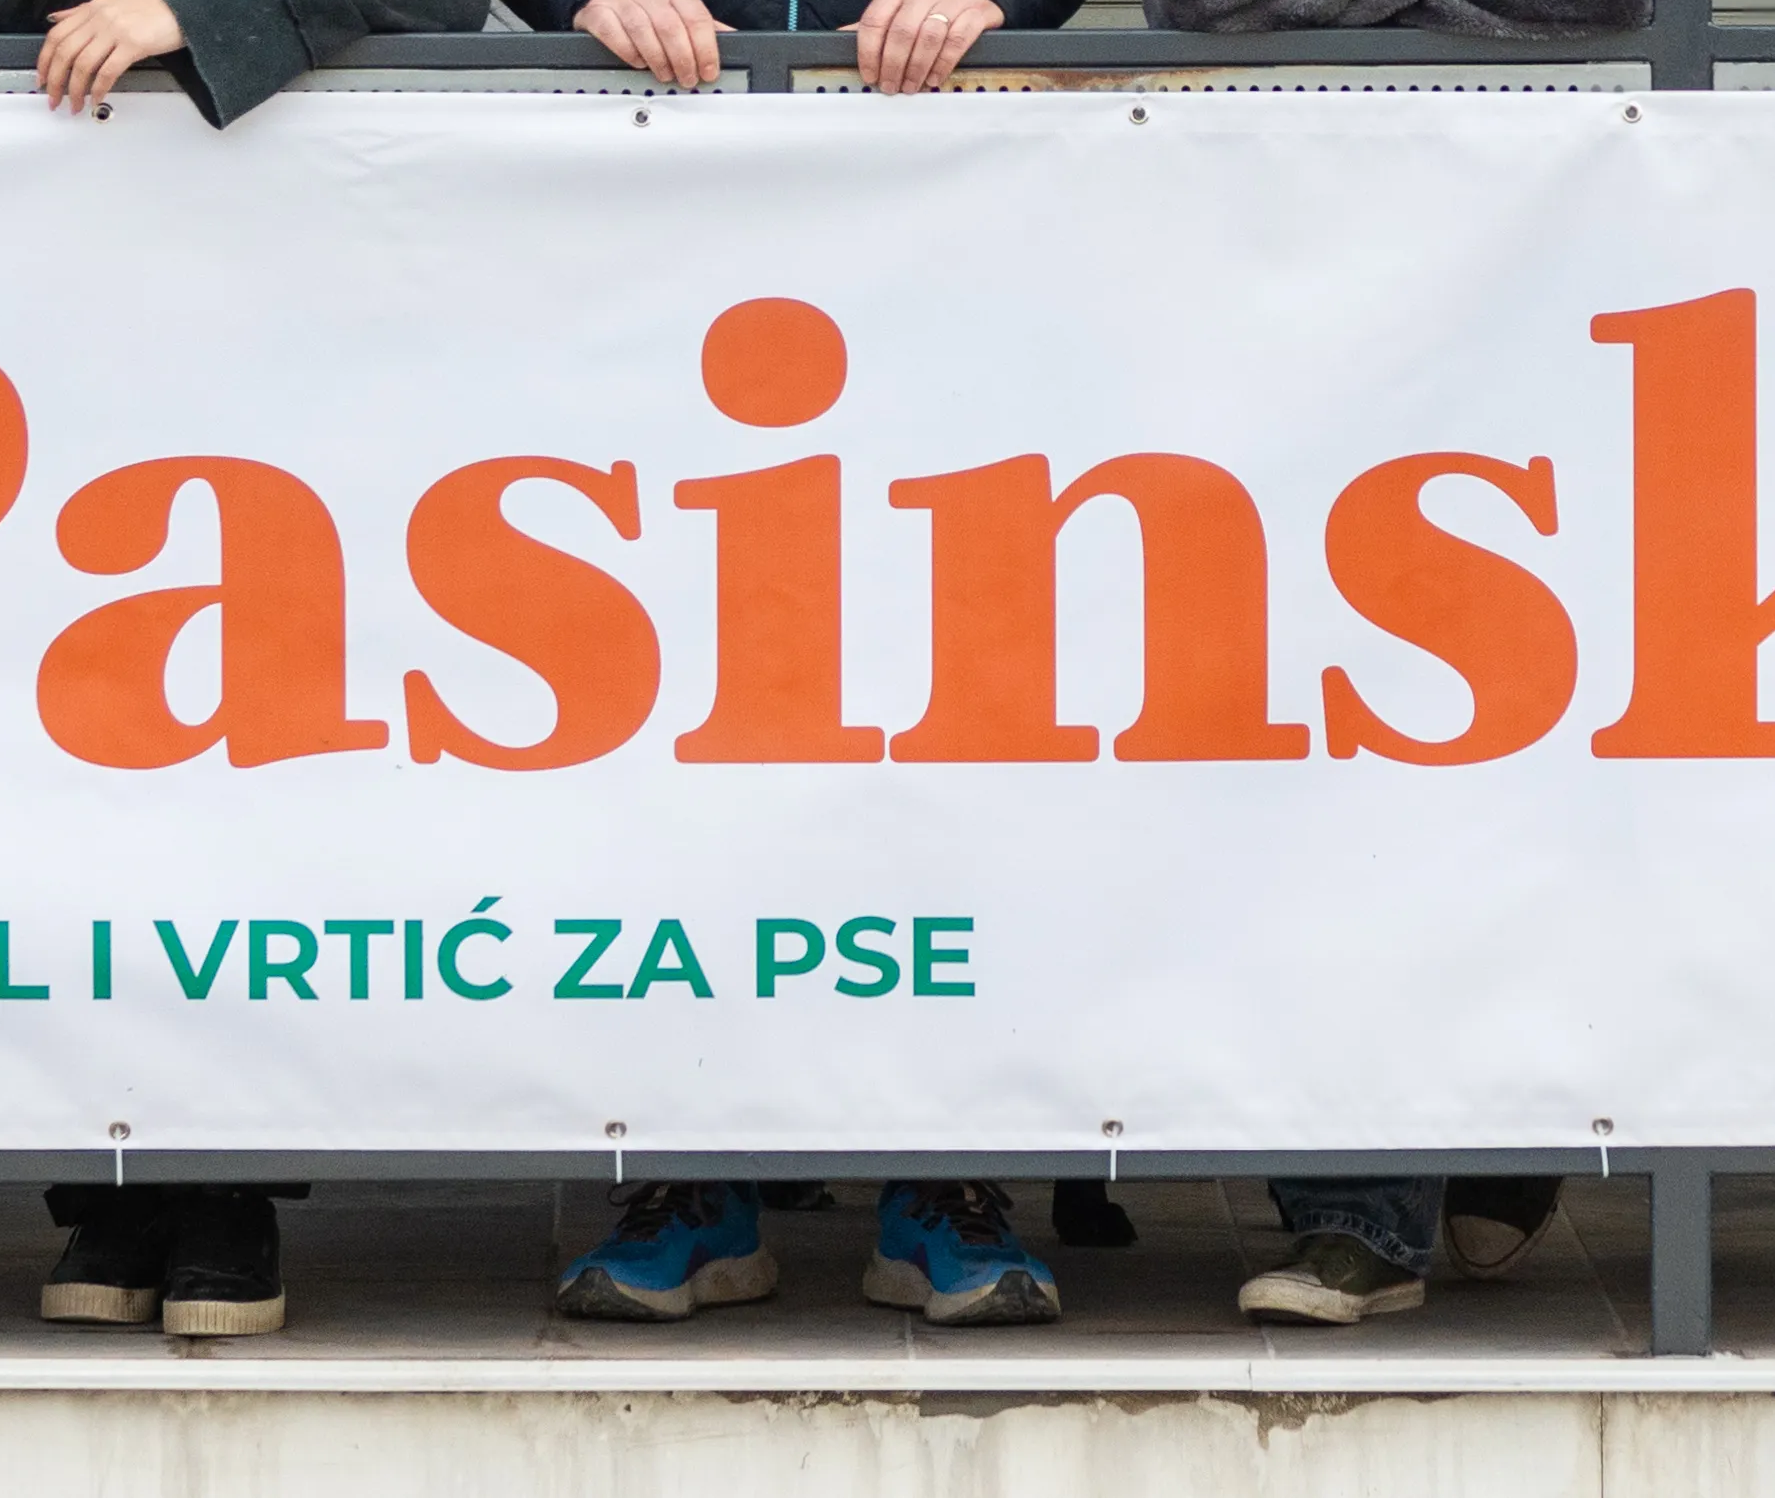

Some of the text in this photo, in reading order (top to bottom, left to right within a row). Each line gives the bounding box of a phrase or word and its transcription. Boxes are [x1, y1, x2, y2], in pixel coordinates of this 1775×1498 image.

[92, 920, 112, 1000] I
[154, 895, 513, 1001] VRTIĆ
[553, 919, 713, 999] ZA
[756, 915, 976, 998] PSE
